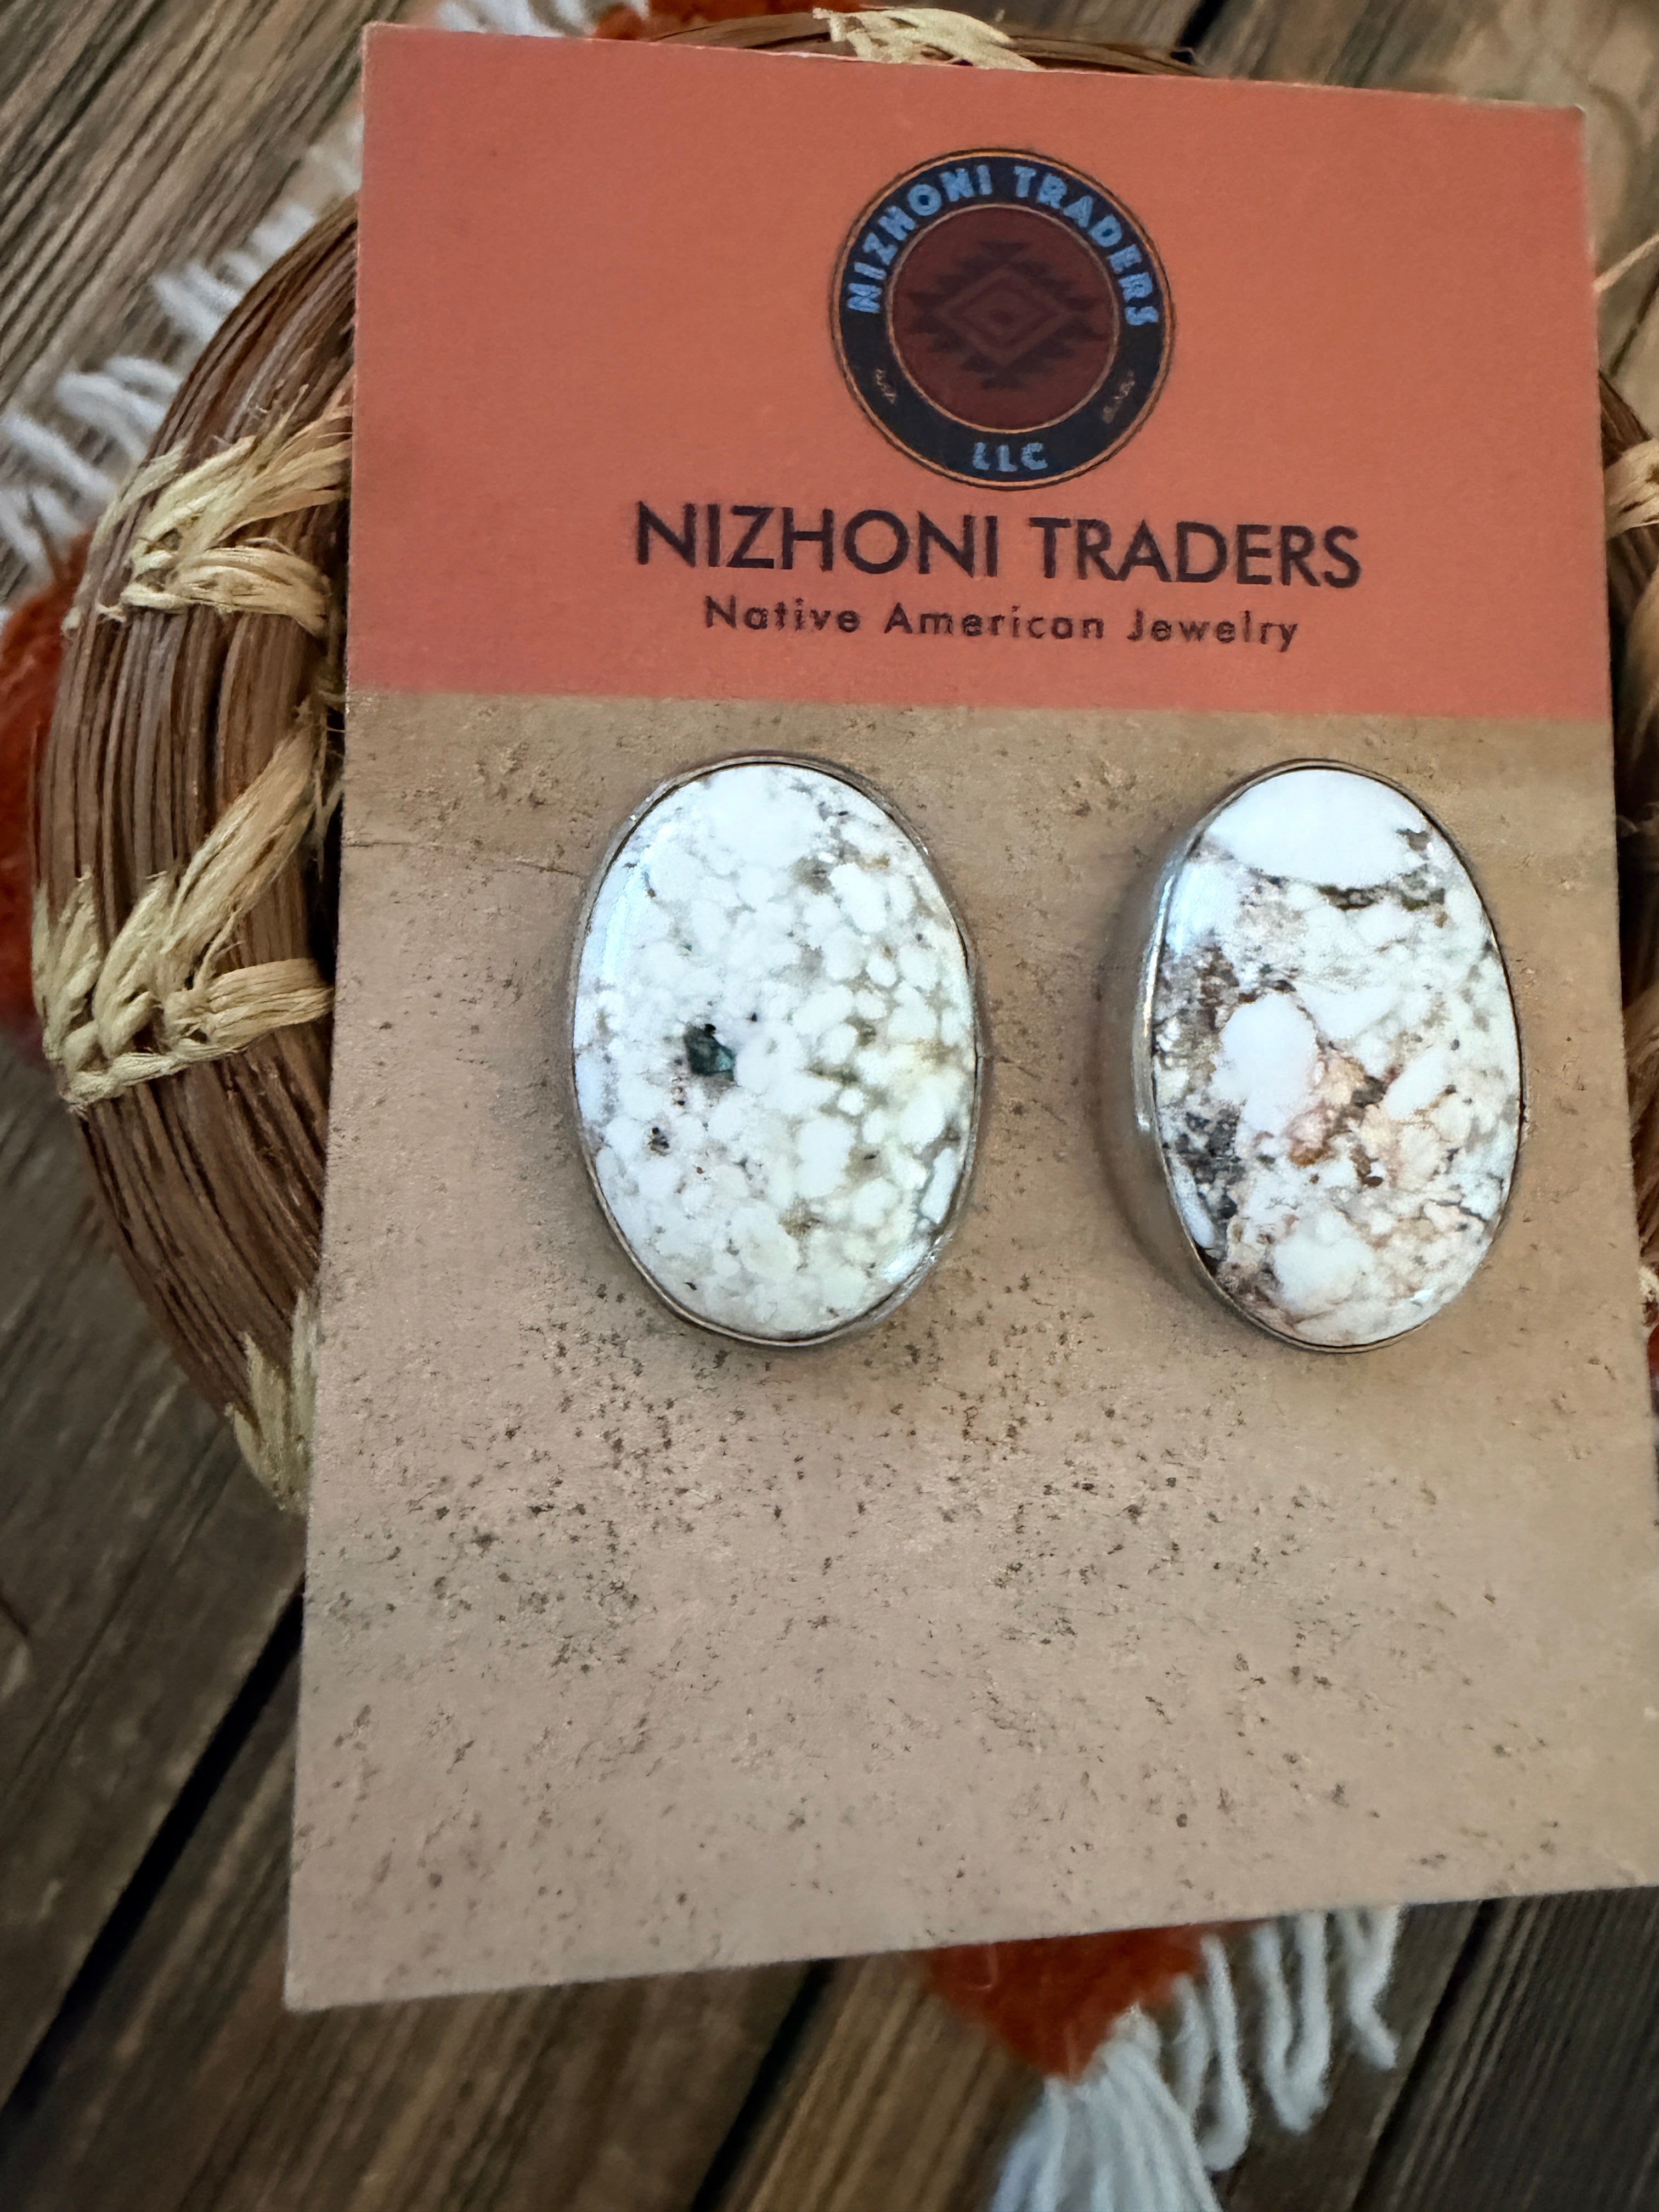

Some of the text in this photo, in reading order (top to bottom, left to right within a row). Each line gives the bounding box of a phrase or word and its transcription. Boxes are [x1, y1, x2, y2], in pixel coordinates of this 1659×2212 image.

[847, 165, 1159, 326] NIZHONI TRADERS
[972, 442, 1048, 472] LLC
[635, 500, 1362, 589] NIZHONI TRADERS
[704, 594, 1299, 653] Native American Jewelry
